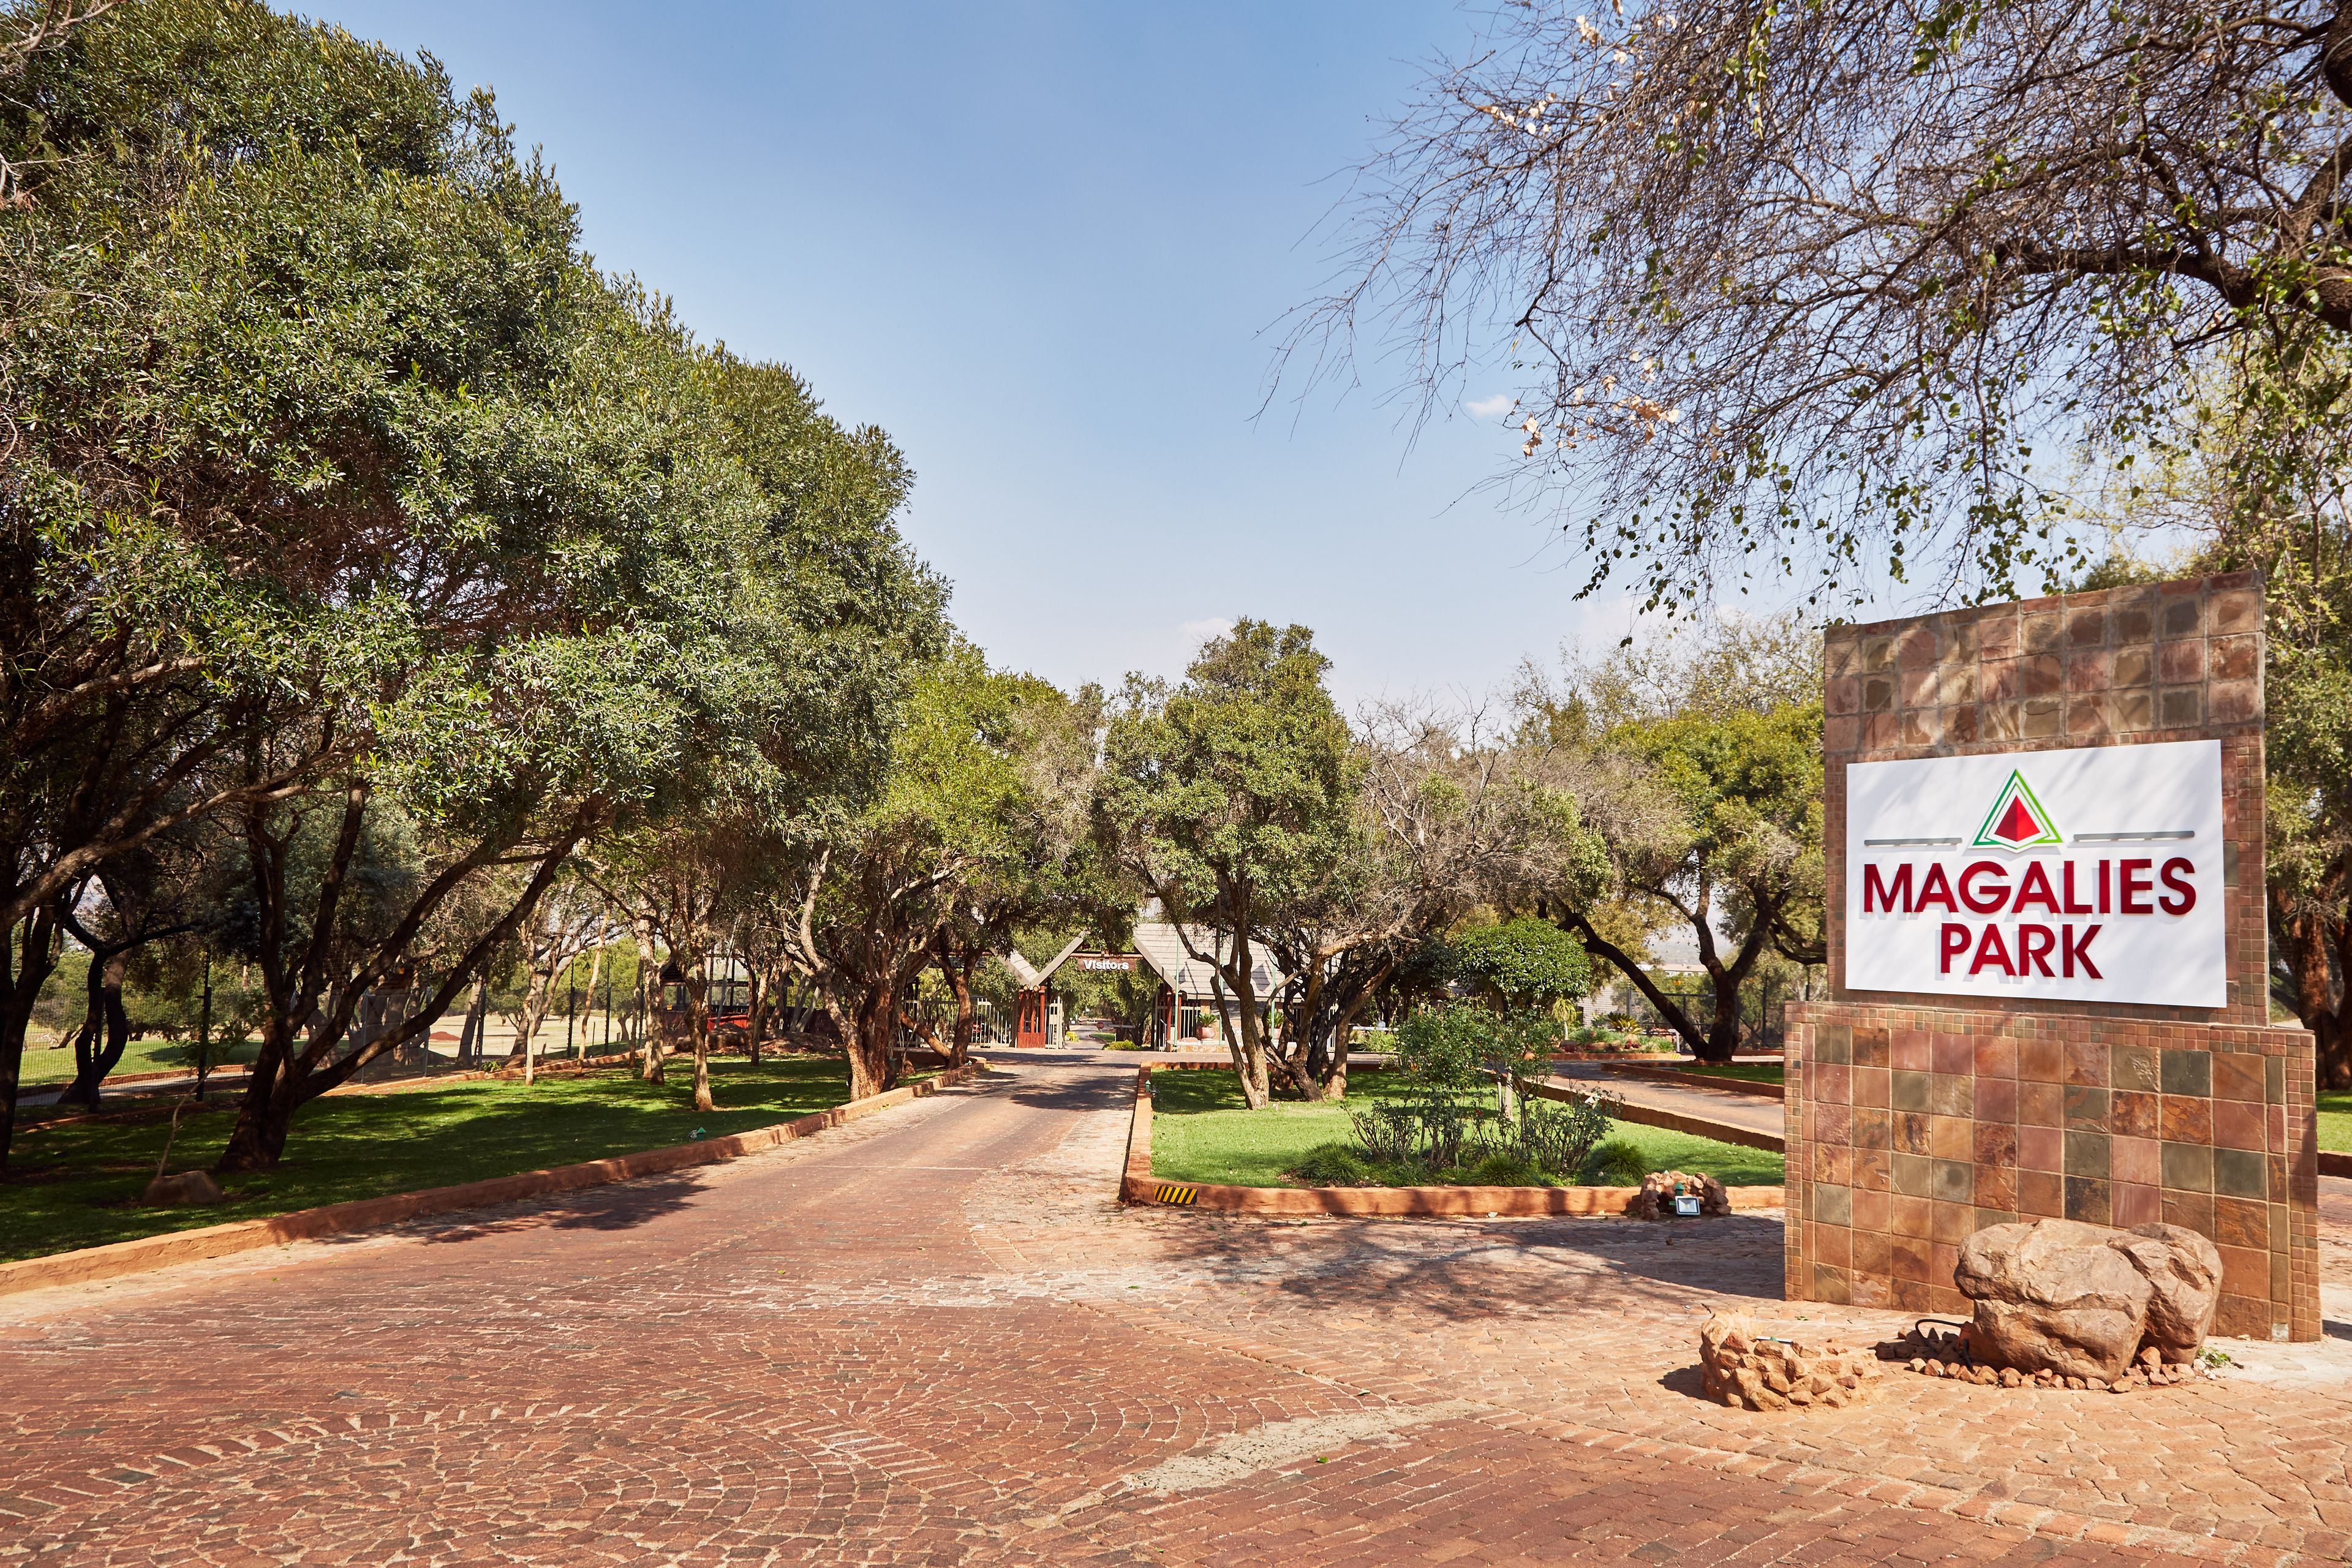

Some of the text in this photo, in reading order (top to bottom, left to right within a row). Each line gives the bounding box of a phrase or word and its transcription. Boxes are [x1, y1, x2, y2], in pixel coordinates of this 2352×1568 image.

[1863, 857, 2196, 915] MAGALIES
[1083, 959, 1129, 970] Visitors
[1940, 922, 2103, 979] PARK
